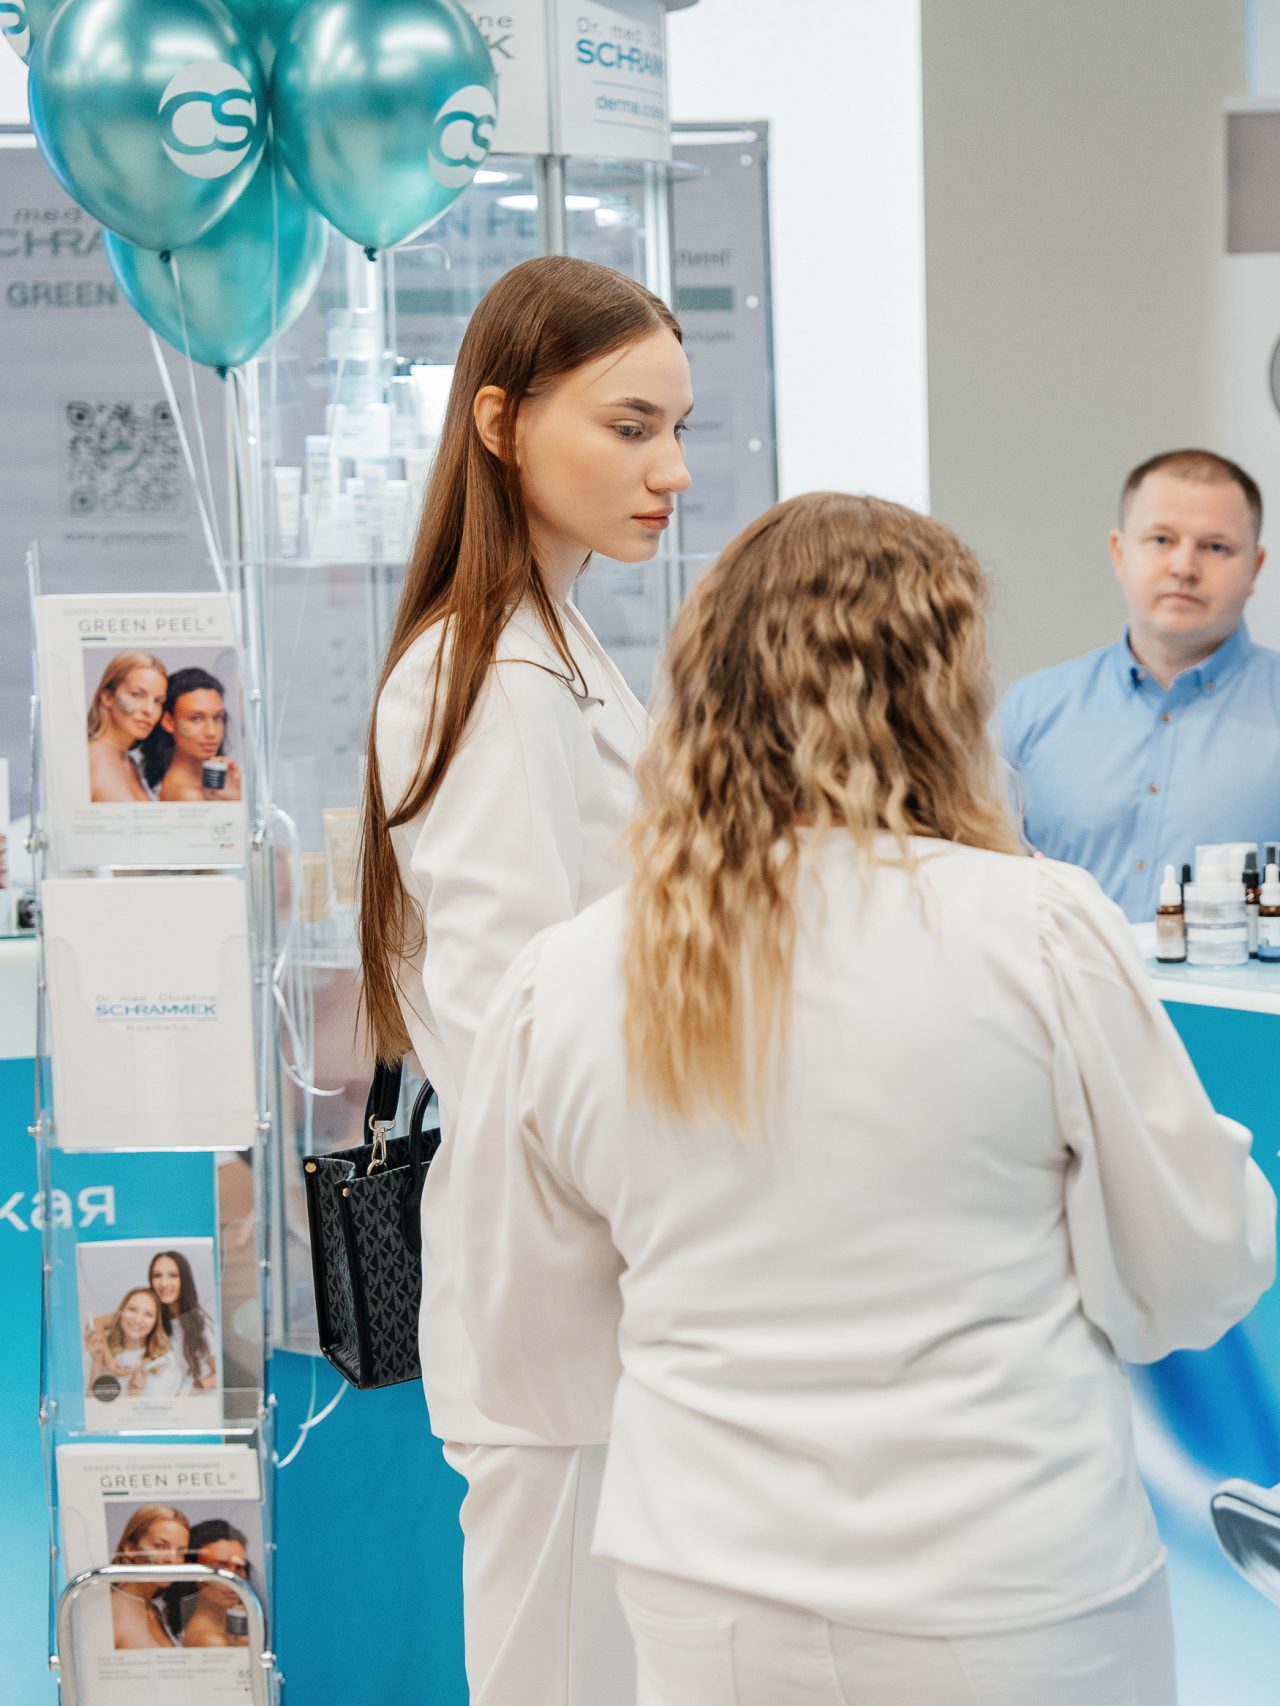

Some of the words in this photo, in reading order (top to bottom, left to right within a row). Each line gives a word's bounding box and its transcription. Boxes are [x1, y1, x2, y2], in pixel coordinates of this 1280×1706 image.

[6, 281, 118, 309] GREEN
[78, 617, 147, 634] GREEN
[95, 1003, 218, 1018] SCHRAMMEK
[99, 1472, 169, 1489] GREEN
